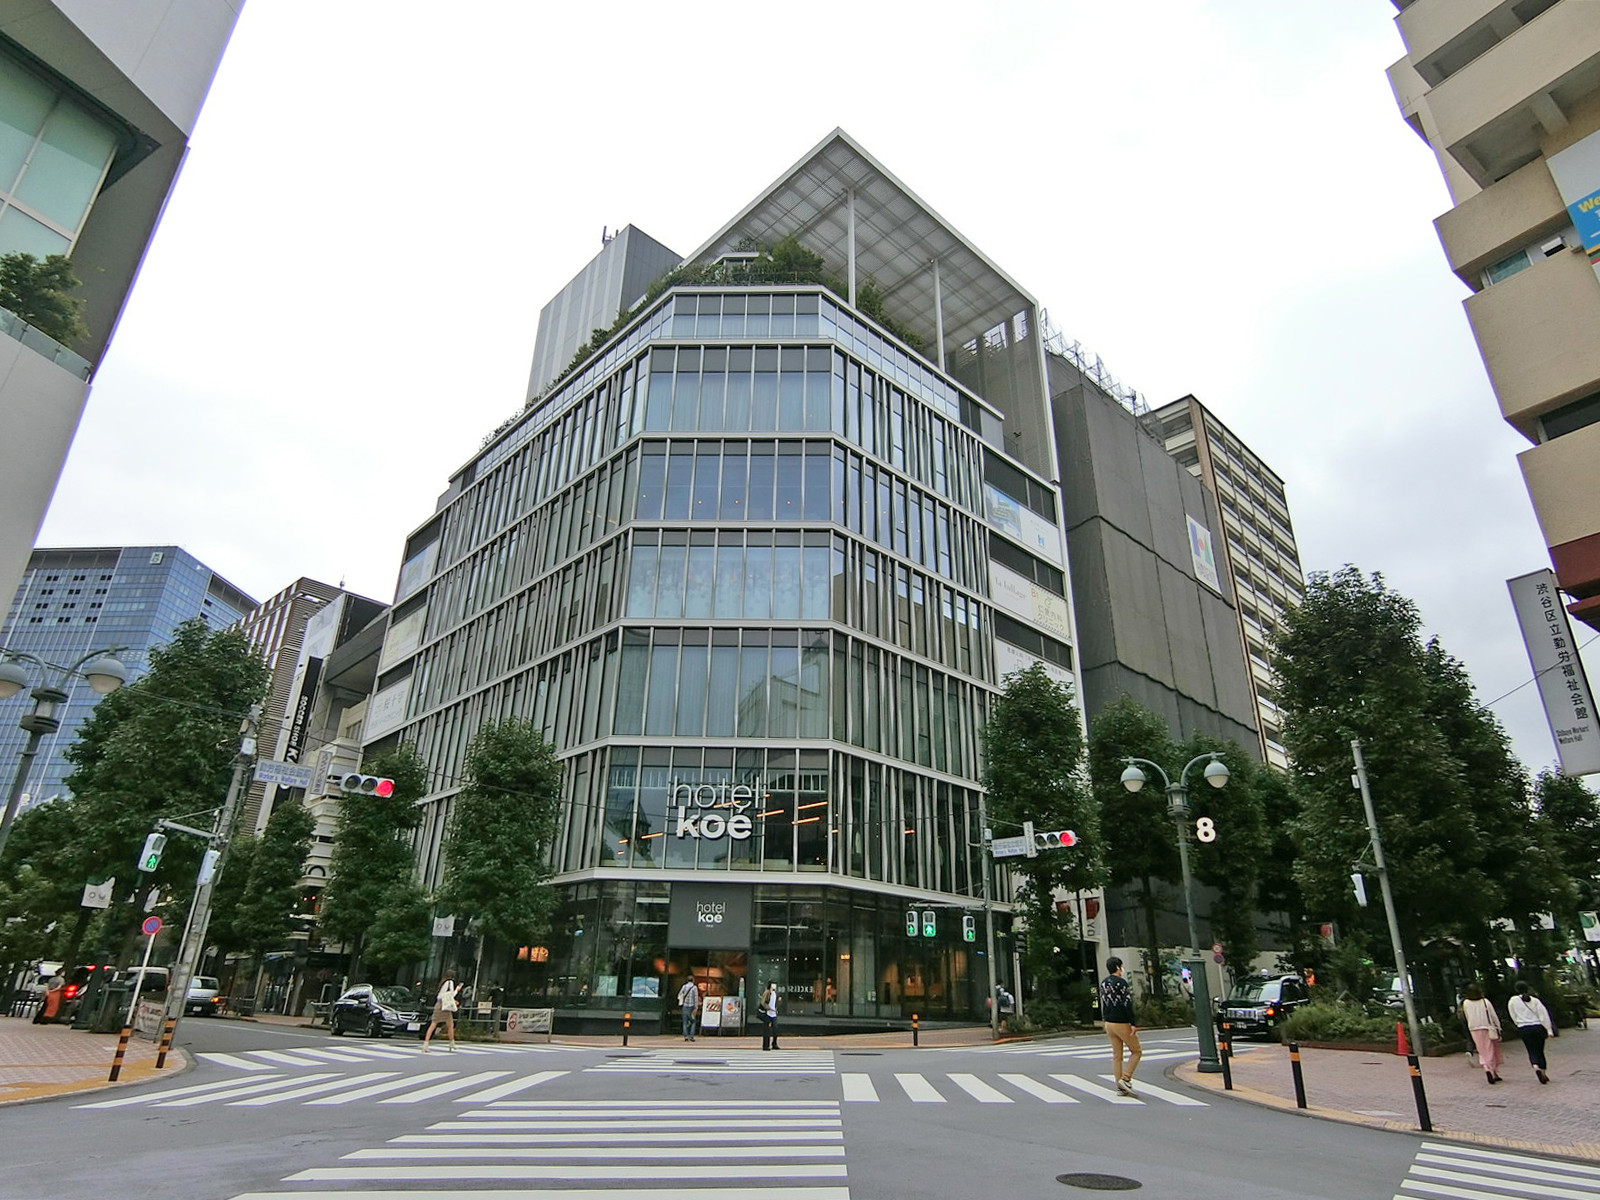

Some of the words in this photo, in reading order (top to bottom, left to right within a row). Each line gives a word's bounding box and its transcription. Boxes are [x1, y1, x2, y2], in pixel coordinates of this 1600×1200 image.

[1536, 583, 1588, 719] 渋谷区立勤労福祉会館
[295, 695, 309, 725] SOCCER
[673, 775, 760, 809] hotel
[1196, 816, 1216, 843] 8
[696, 901, 726, 913] hotel
